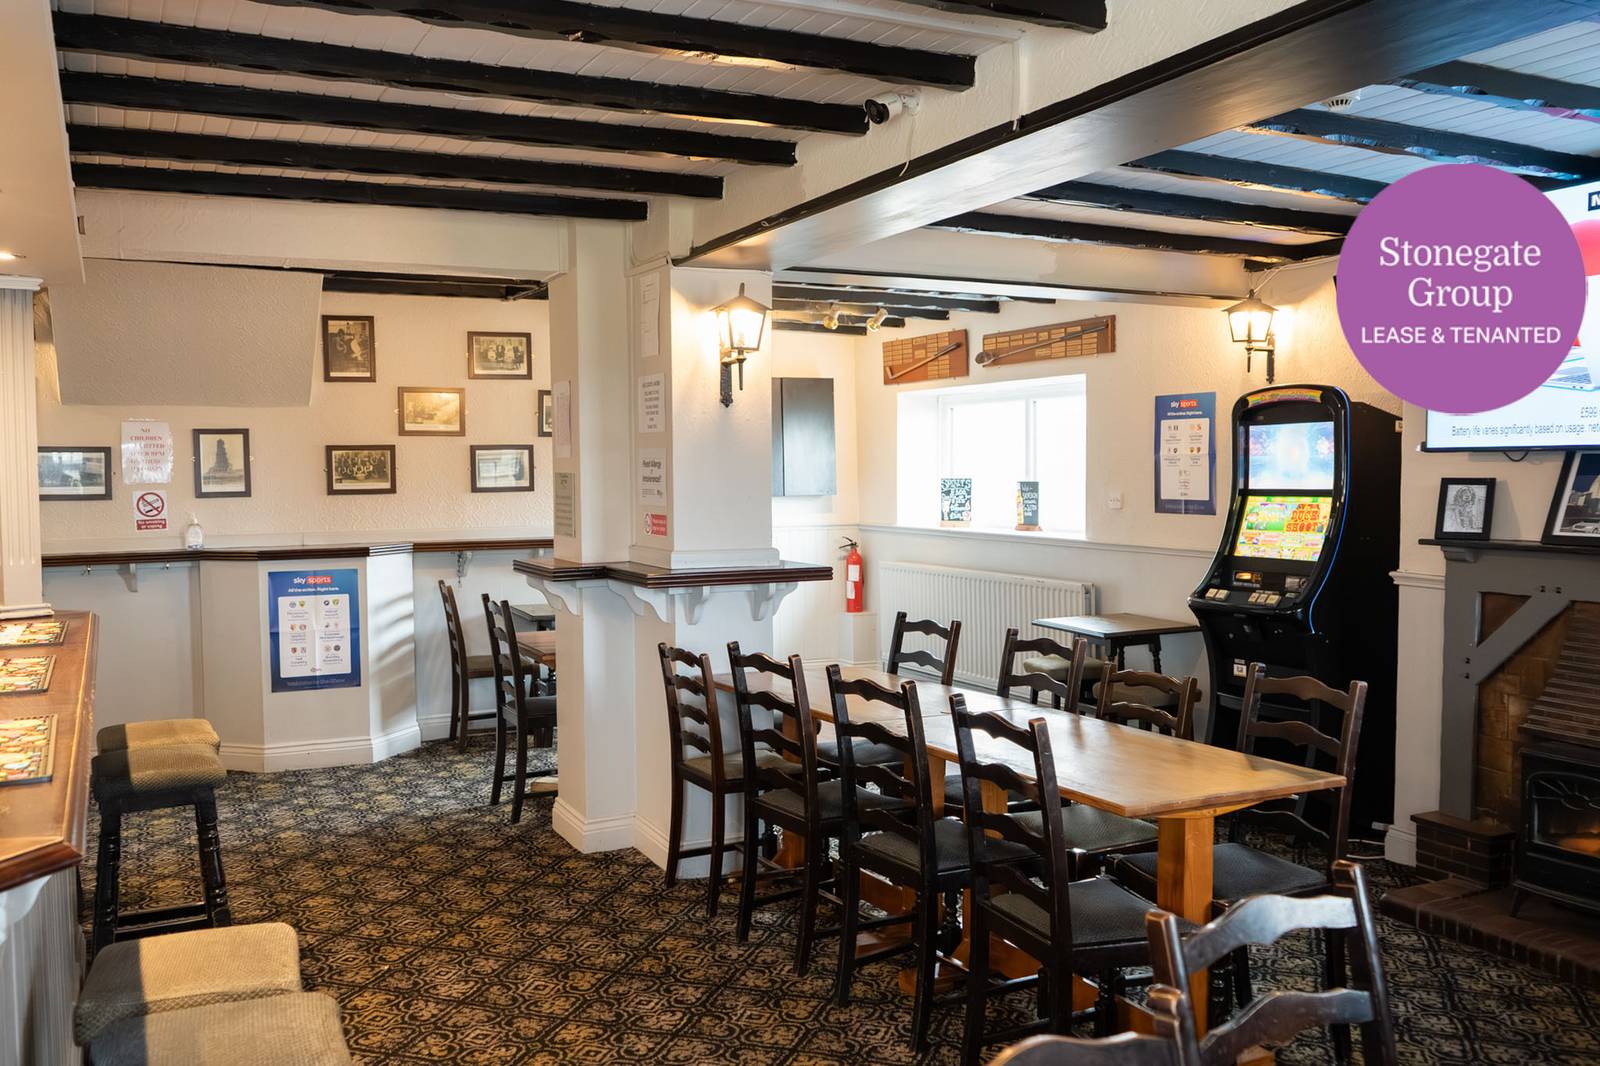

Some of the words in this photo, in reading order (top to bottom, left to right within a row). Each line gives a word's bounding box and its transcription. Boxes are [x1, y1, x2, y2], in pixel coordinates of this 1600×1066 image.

[1170, 400, 1179, 408] sky
[1180, 400, 1197, 408] sports
[1500, 424, 1533, 437] significantly
[1535, 423, 1554, 434] based
[1555, 425, 1564, 434] on
[1291, 510, 1319, 521] DUCK
[1285, 522, 1318, 532] SHOOT
[293, 576, 305, 584] sky
[307, 576, 332, 584] sports
